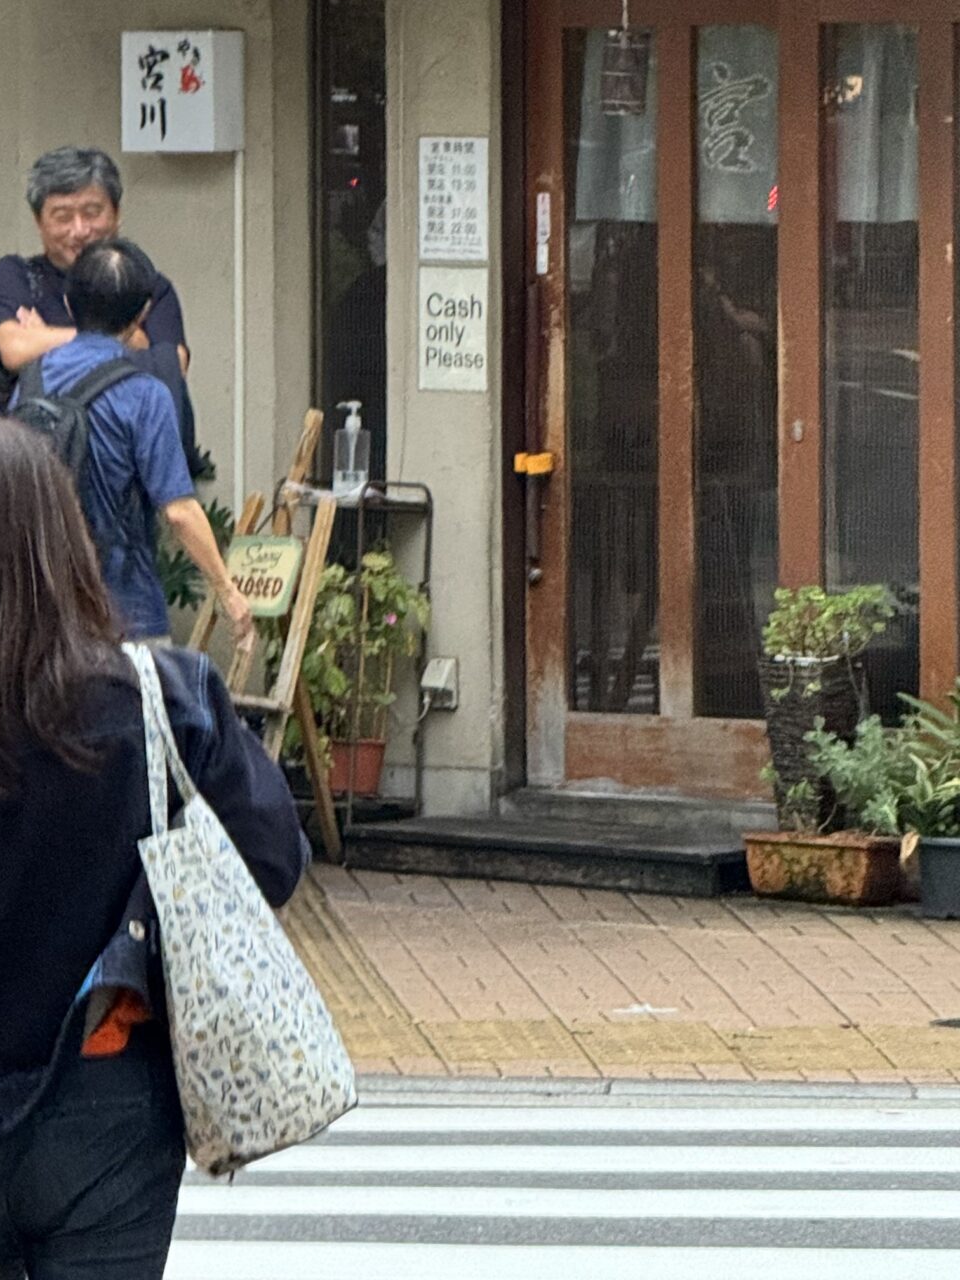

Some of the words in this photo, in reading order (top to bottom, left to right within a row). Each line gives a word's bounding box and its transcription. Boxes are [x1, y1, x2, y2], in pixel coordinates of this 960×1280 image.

[138, 44, 170, 142] 宮川
[426, 292, 482, 319] Cash
[426, 321, 466, 348] only
[425, 346, 484, 369] Please
